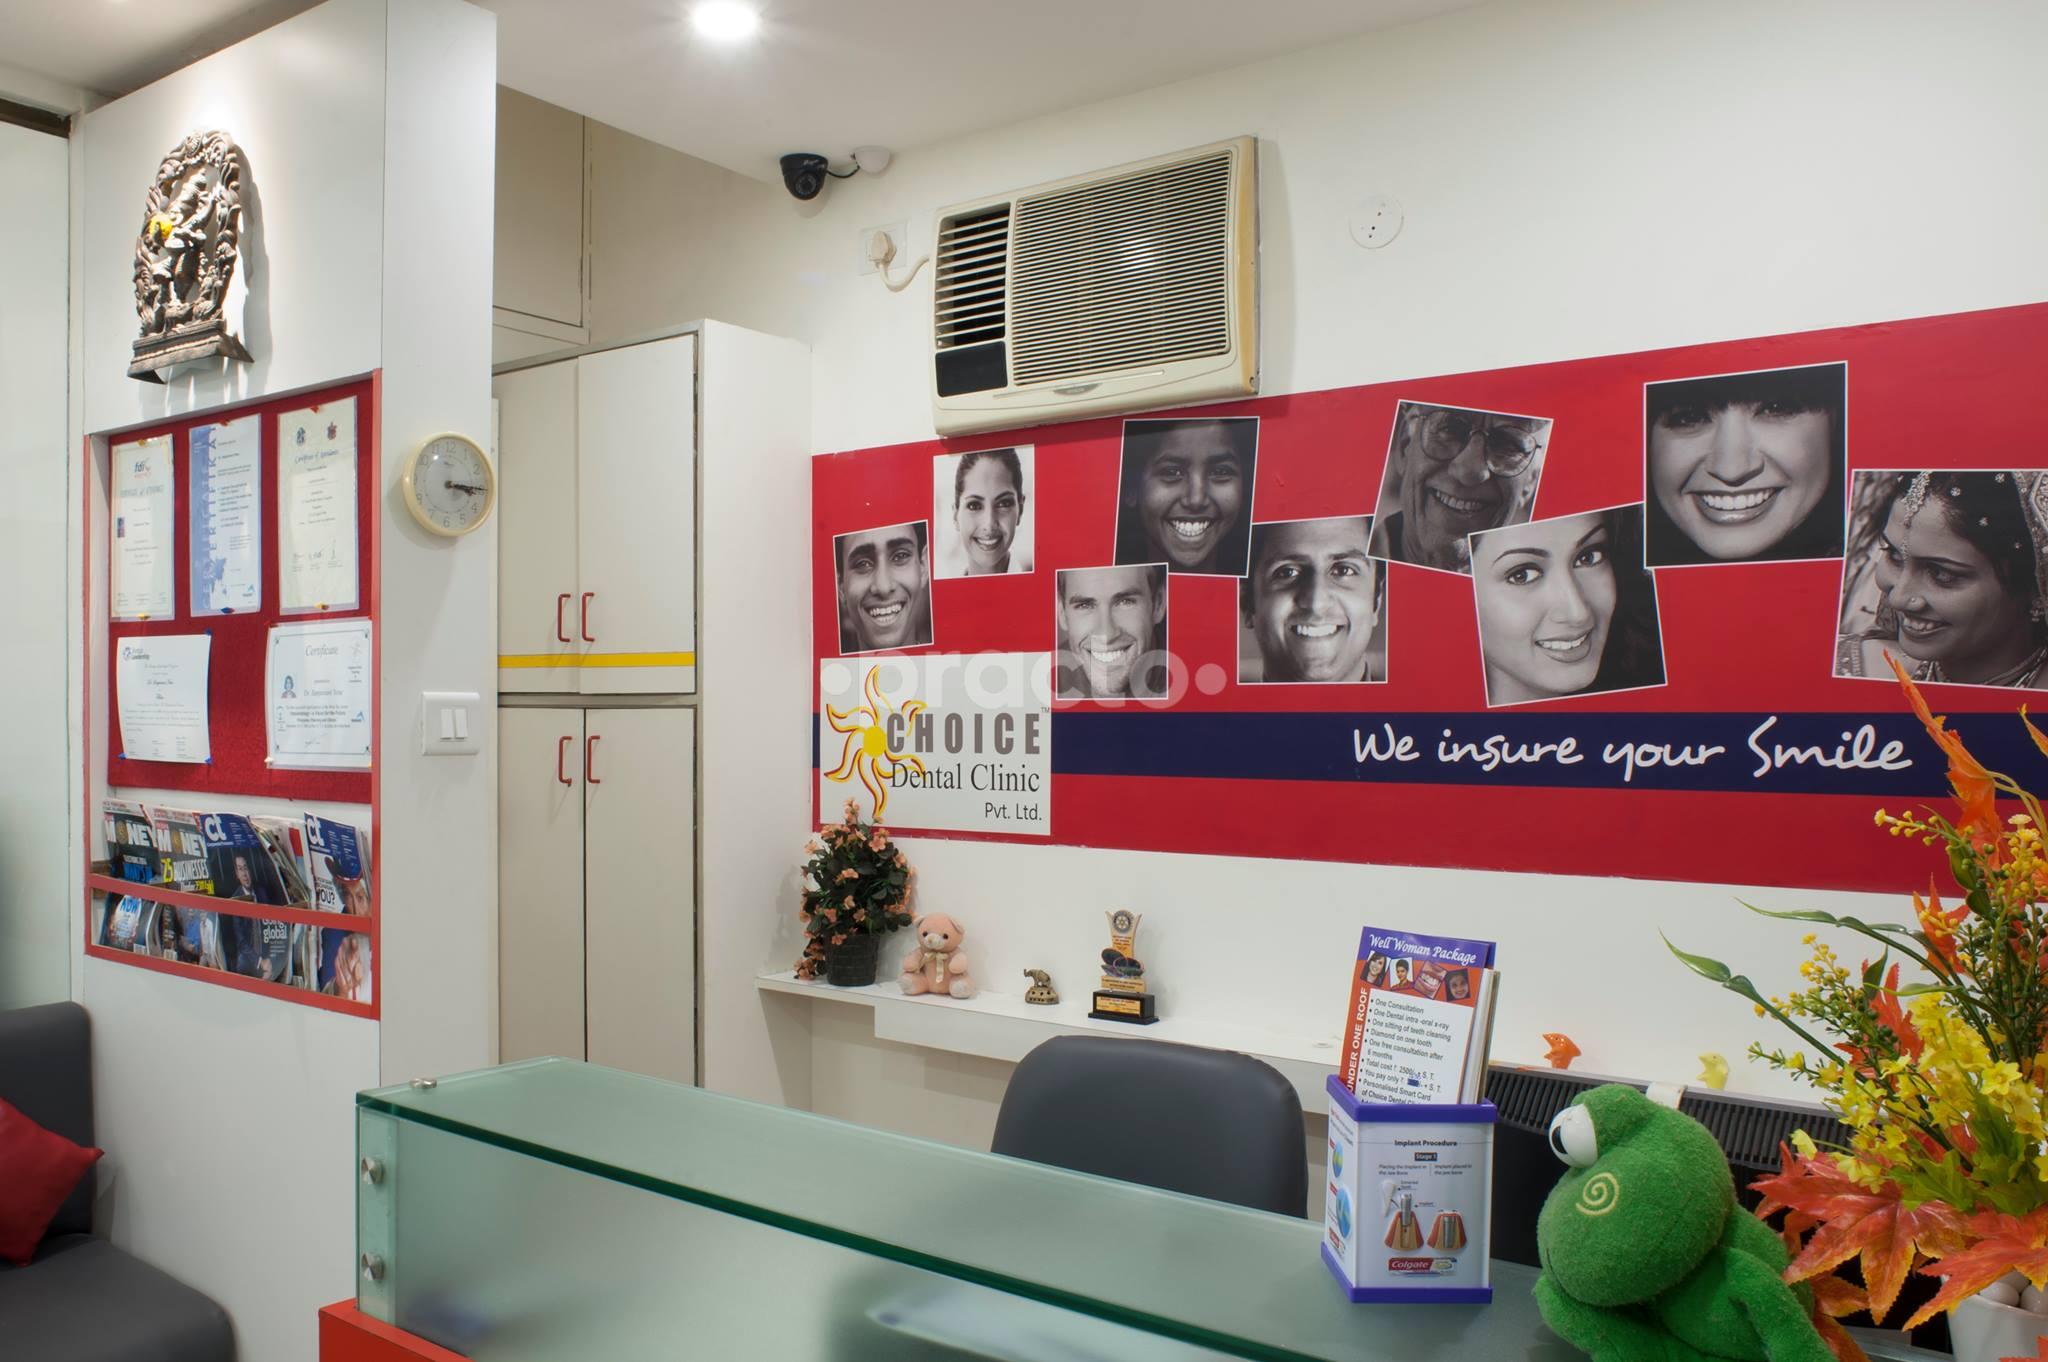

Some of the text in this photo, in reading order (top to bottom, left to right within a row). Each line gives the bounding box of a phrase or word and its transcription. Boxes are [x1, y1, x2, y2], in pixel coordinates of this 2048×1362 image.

[446, 442, 456, 454] 12
[473, 464, 480, 475] 2
[443, 516, 450, 528] 6
[886, 711, 1040, 755] CHOICE
[1353, 715, 1913, 782] We insure your Smile
[891, 762, 1040, 793] Dental Clinic
[985, 803, 1042, 822] Pvt. Ltd.
[160, 857, 174, 883] 25
[263, 926, 288, 944] global
[1369, 934, 1477, 966] Well Woman Package
[1374, 1008, 1385, 1017] One
[1386, 1011, 1404, 1020] Dental
[1375, 998, 1424, 1014] One Consultation
[1370, 1028, 1395, 1040] Diamond
[1417, 1038, 1432, 1048] tooth
[1372, 1018, 1384, 1026] One
[1384, 1021, 1402, 1032] sitting
[1410, 1027, 1425, 1035] teeth
[1426, 1030, 1451, 1042] cleaning
[1346, 987, 1368, 1092] UNDER ONE ROOF
[1369, 1038, 1444, 1060] One free consultation after
[1372, 1050, 1392, 1060] months
[1366, 1058, 1380, 1067] Total
[1380, 1062, 1393, 1071] cost
[1365, 1068, 1375, 1077] You
[1376, 1072, 1386, 1081] pay
[1387, 1074, 1399, 1084] only
[1362, 1079, 1398, 1094] Personalised
[1399, 1087, 1416, 1098] Smart
[1417, 1092, 1432, 1101] Card
[1368, 1090, 1388, 1100] Choice
[1392, 1260, 1429, 1270] Colgate
